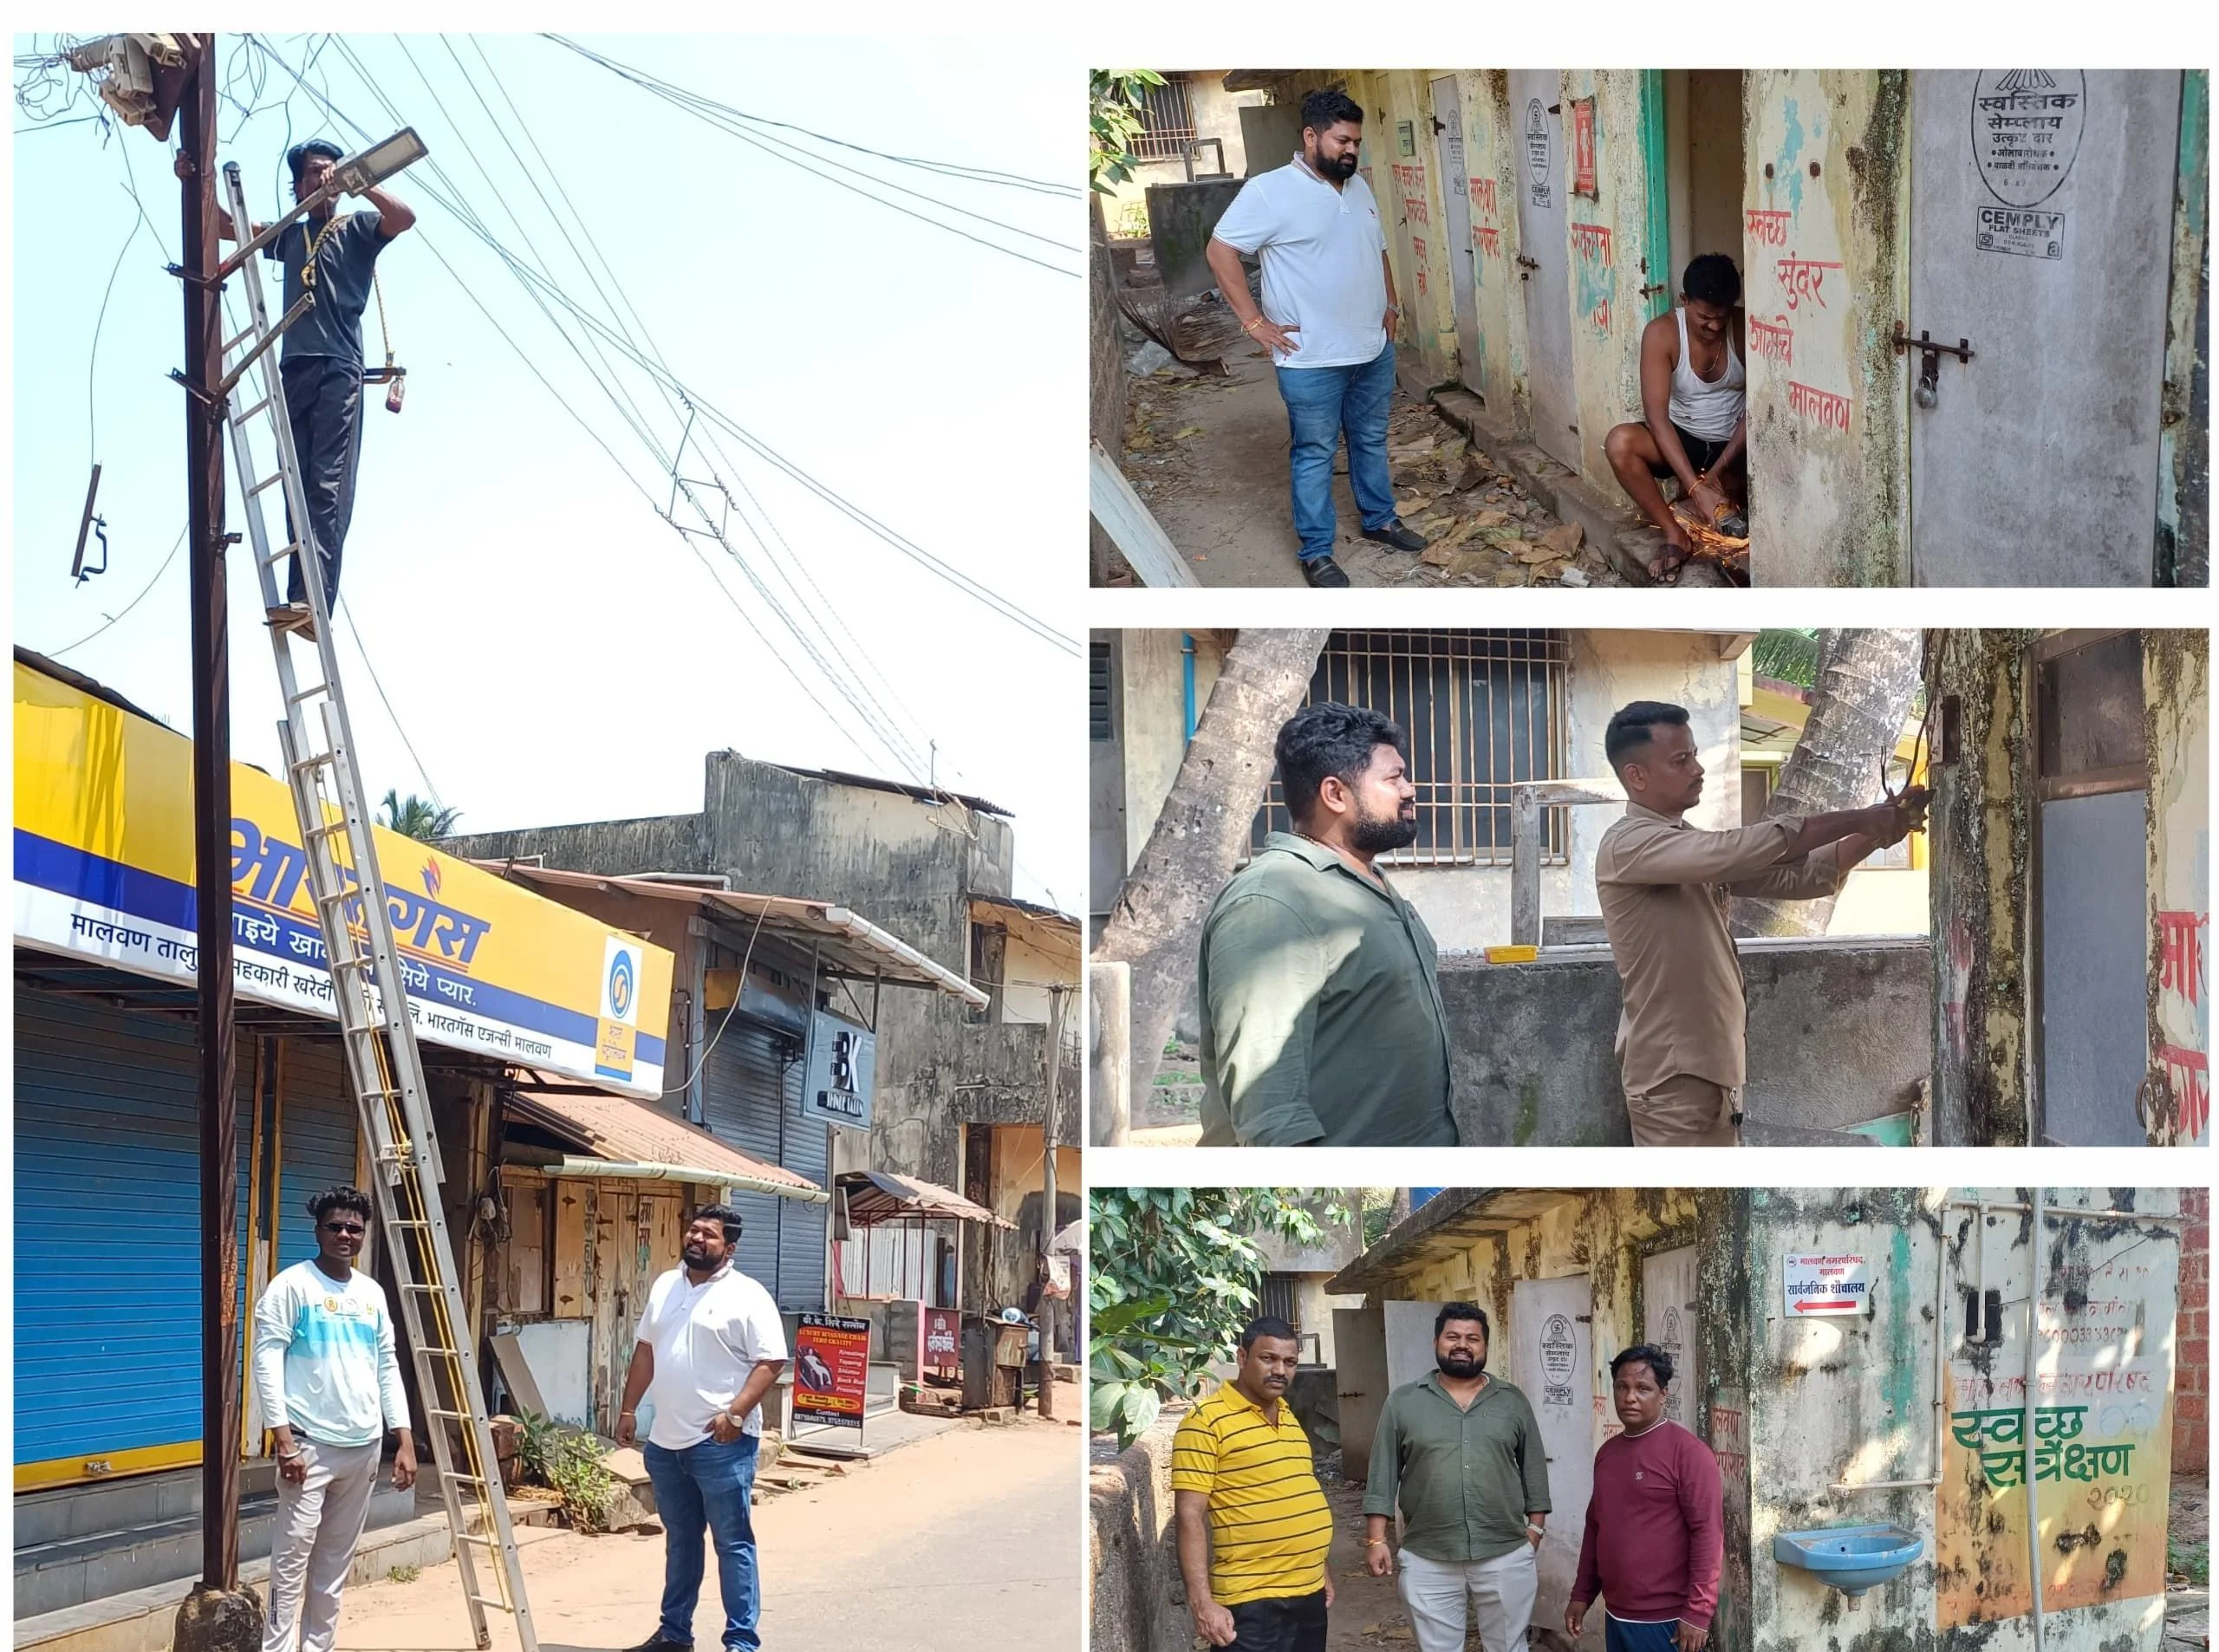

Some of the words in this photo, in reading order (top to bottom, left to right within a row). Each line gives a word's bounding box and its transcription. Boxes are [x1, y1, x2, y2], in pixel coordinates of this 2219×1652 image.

[1981, 211, 2059, 230] CEMPLY
[1988, 224, 2010, 233] FLAT
[2013, 227, 2050, 237] SHEETS
[1778, 250, 1844, 309] सुंदर
[1788, 381, 1853, 434] मालवण
[71, 914, 152, 953] मालवण
[515, 1038, 552, 1059] मालवण
[1787, 1280, 1828, 1295] सार्वजनिक
[1831, 1279, 1865, 1294] शौचालय
[1951, 1406, 2088, 1448] स्वच्छ
